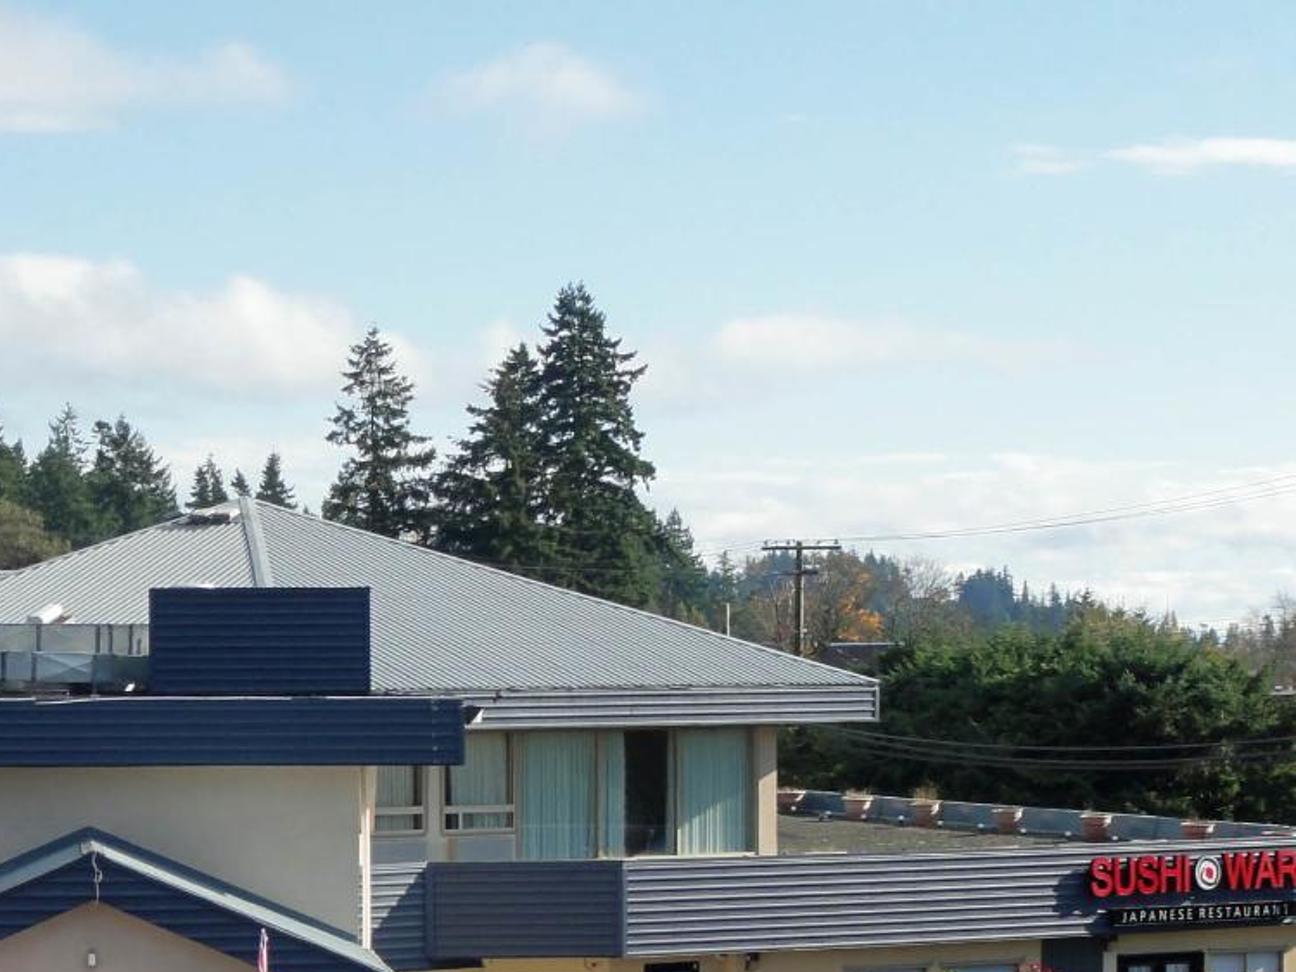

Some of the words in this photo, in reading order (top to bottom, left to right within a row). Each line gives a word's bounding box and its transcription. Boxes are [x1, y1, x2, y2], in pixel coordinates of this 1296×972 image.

[1090, 854, 1192, 898] SUSHI
[1122, 908, 1193, 923] JAPANESE
[1198, 903, 1289, 919] RESTAURANT
